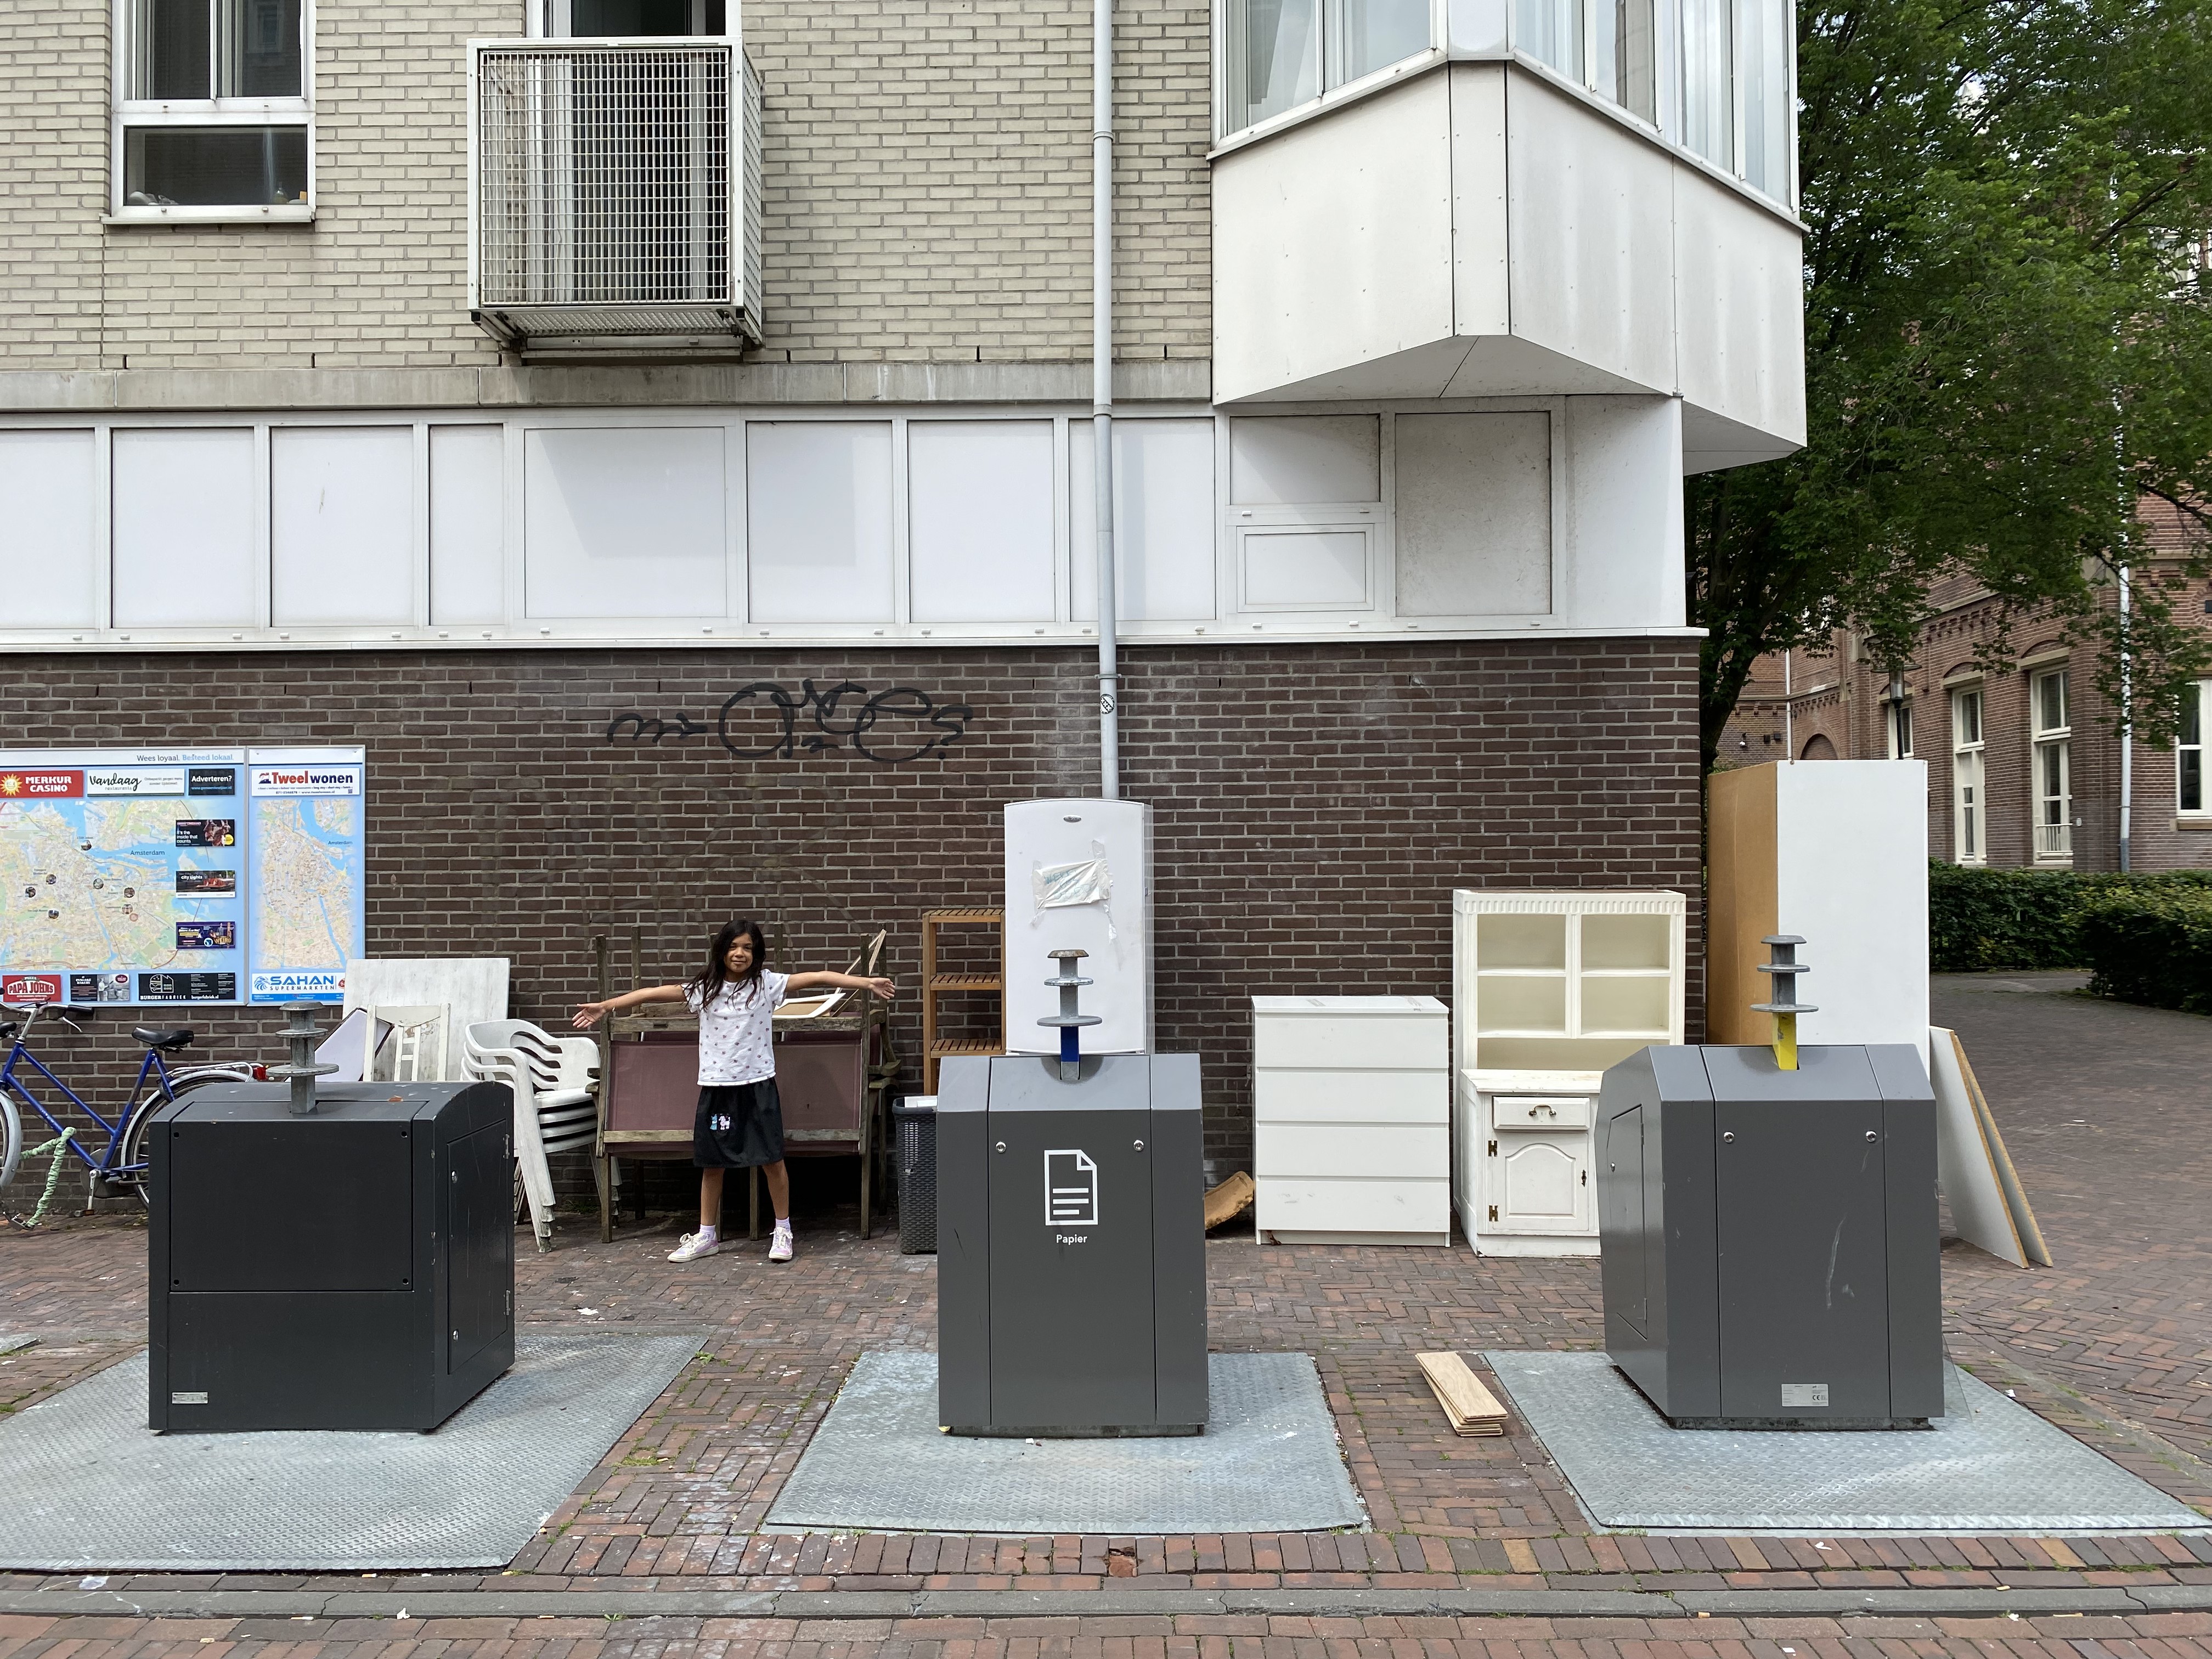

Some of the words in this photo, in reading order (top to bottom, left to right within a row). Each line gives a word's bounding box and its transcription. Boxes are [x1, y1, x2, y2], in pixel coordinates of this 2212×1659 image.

[157, 754, 180, 763] loyaal.
[25, 776, 72, 784] MERKUR
[89, 772, 142, 791] Vandaag
[270, 975, 334, 985] SAHAN
[9, 983, 28, 994] PAPA
[1056, 1233, 1088, 1245] Papier
